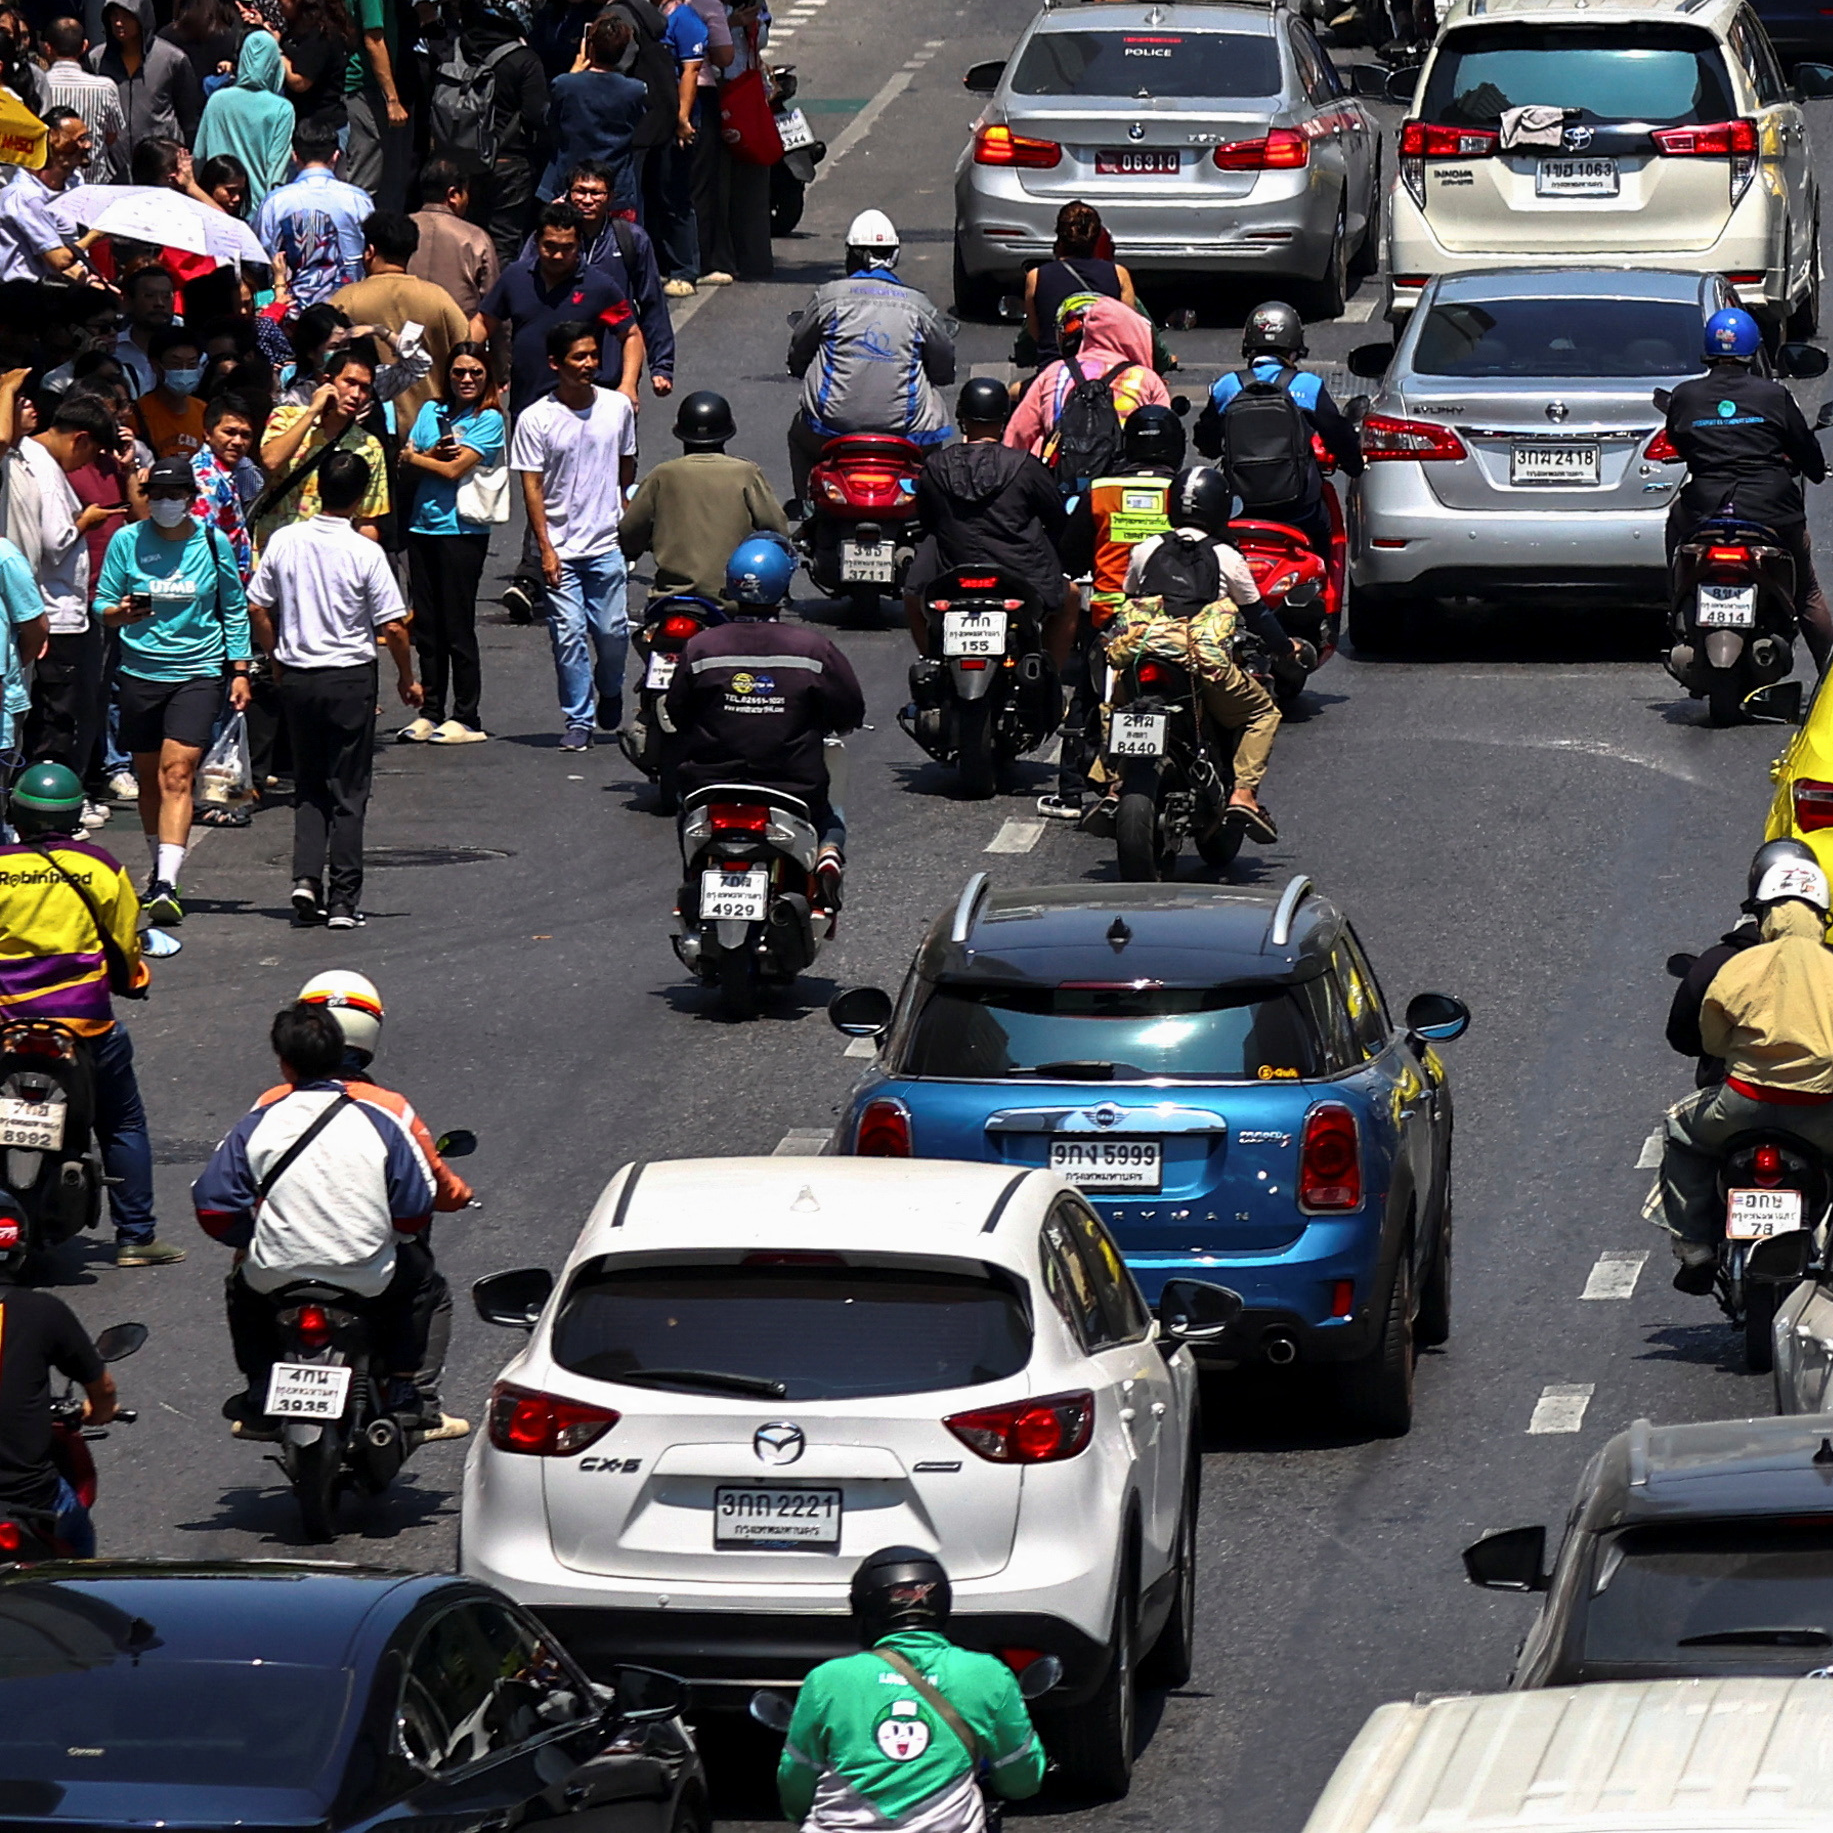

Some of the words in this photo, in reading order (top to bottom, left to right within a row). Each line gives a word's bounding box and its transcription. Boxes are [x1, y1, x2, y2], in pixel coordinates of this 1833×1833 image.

[1124, 47, 1173, 58] POLICE
[1122, 148, 1178, 172] 06310
[1554, 449, 1595, 467] 2418
[1706, 612, 1746, 625] 4814
[960, 640, 990, 653] 155
[1116, 741, 1157, 756] 8440
[711, 903, 756, 917] 4929
[1103, 1143, 1155, 1167] 5999
[279, 1399, 329, 1414] 3935
[775, 1492, 835, 1518] 2221
